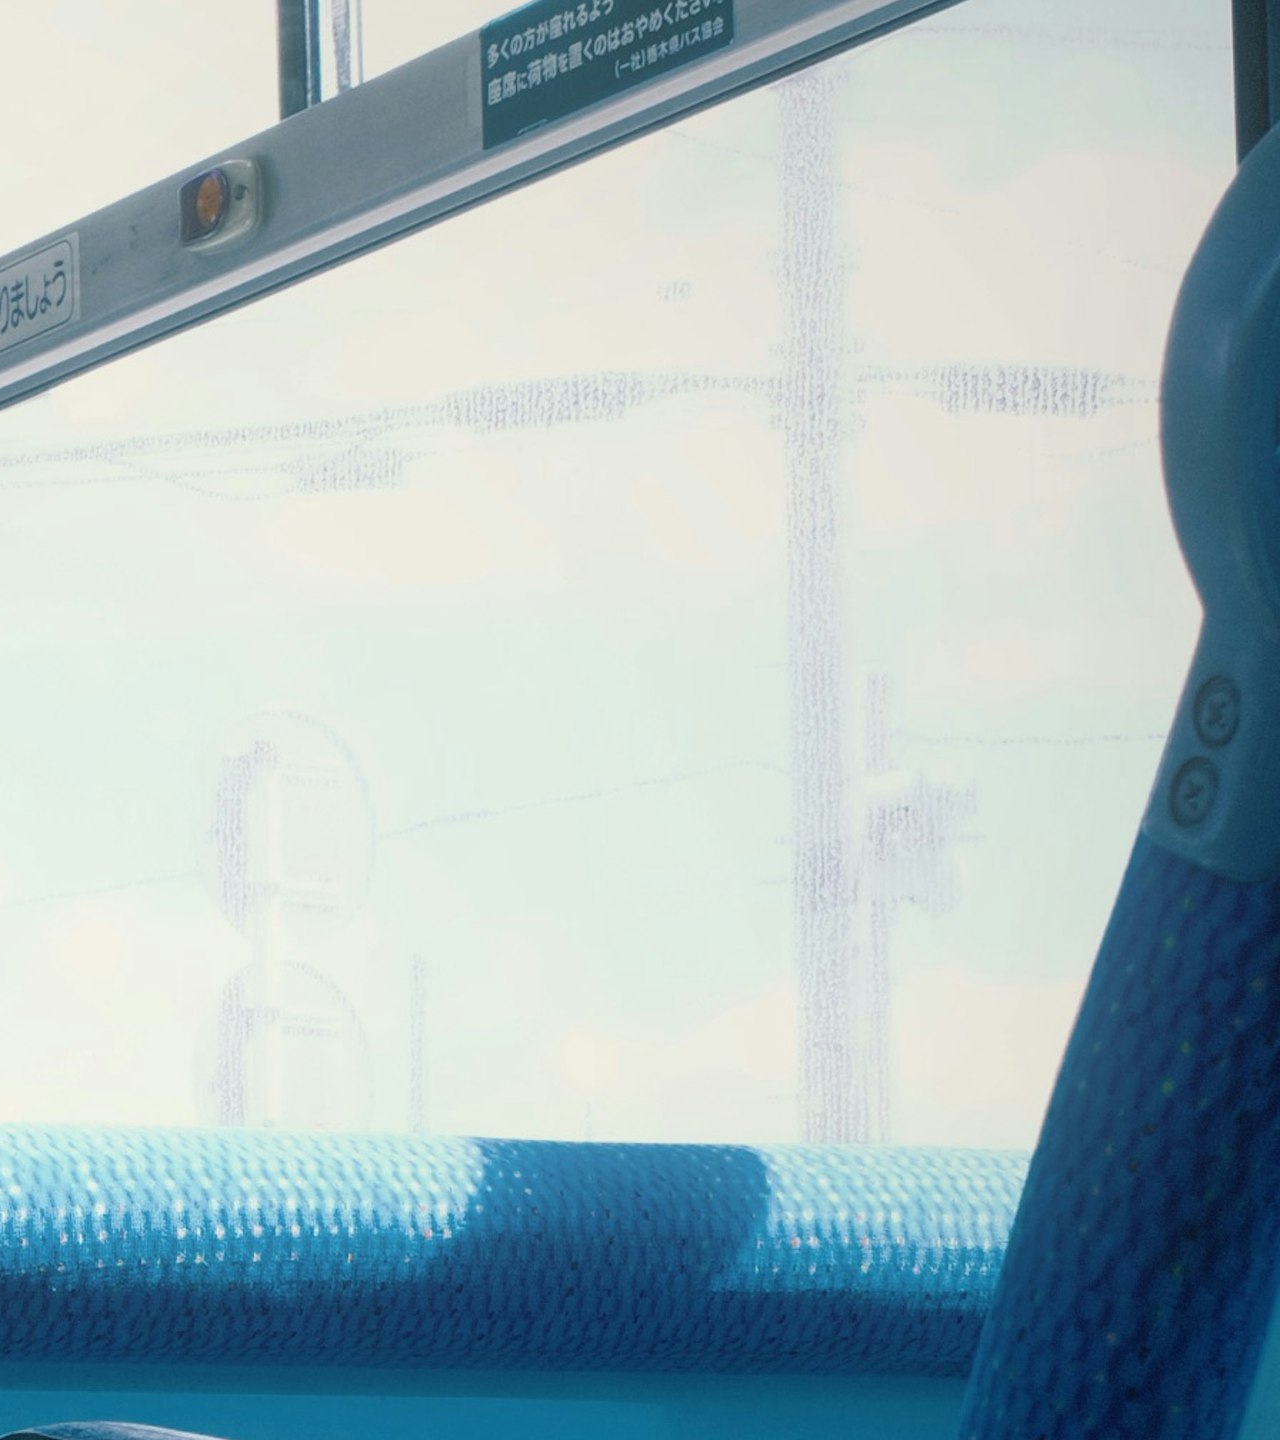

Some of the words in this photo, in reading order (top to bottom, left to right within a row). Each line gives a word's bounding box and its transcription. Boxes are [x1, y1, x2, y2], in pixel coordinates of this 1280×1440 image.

[613, 16, 725, 79] (一社)栃木県バス協会
